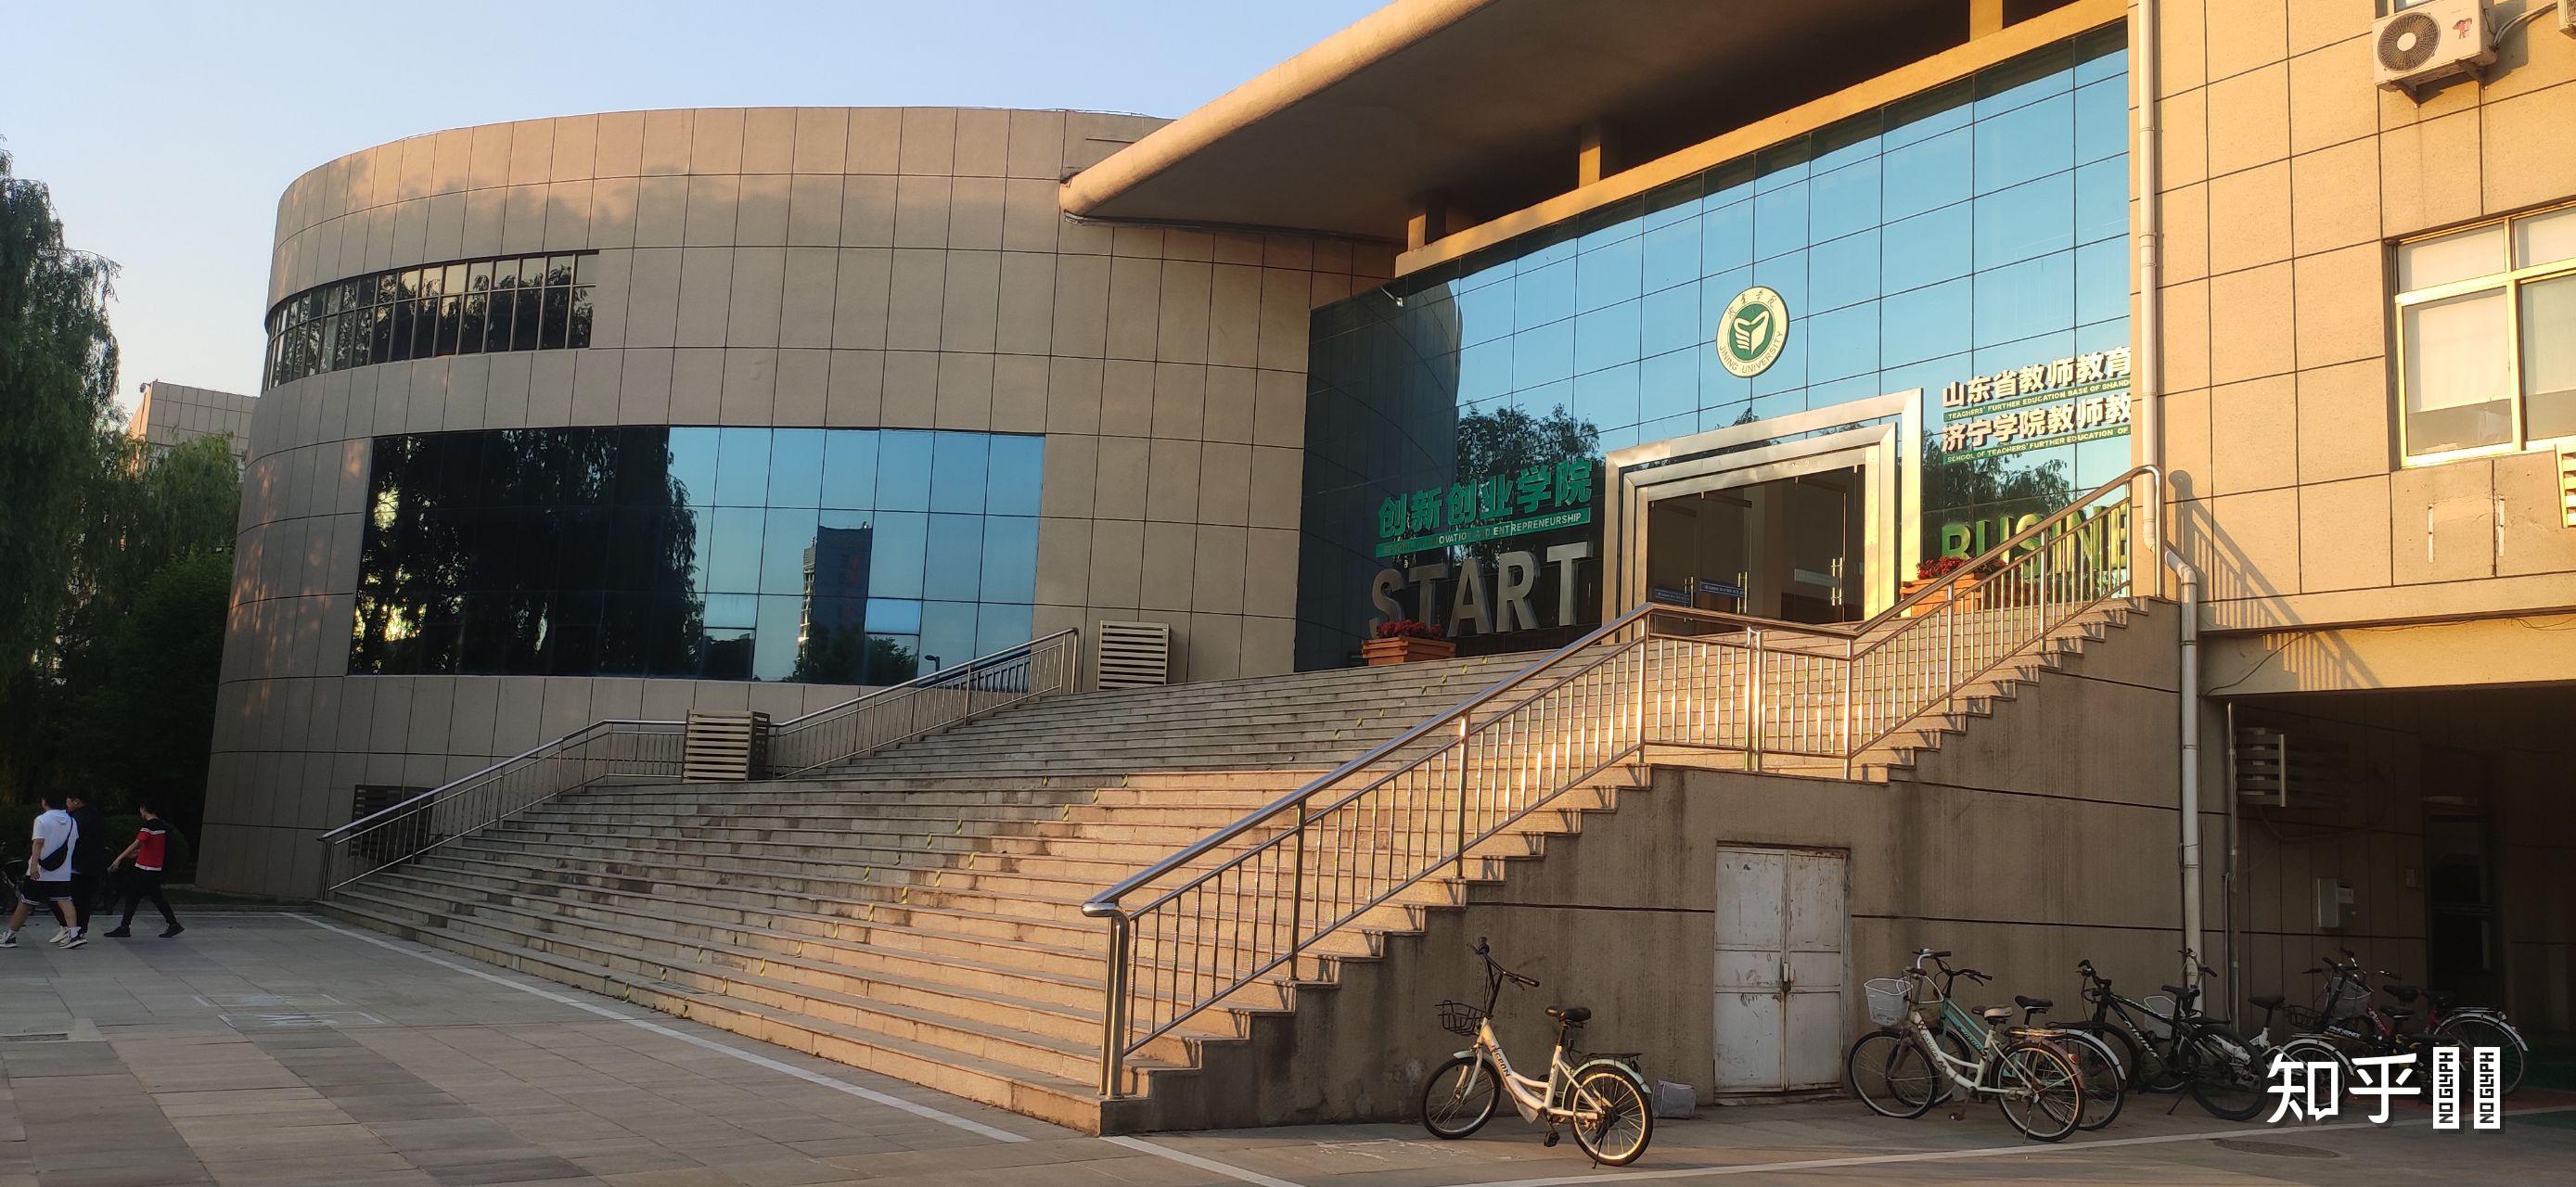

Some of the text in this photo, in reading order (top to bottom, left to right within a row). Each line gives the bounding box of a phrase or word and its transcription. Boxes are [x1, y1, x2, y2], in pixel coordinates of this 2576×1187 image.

[1741, 331, 1783, 374] UNIVERSITY
[1942, 346, 2132, 408] 山东省教师教育
[1987, 400, 2021, 412] FURTHER
[2022, 391, 2066, 405] EDUCATION
[2067, 386, 2089, 396] BASE
[2090, 384, 2102, 392] OF
[2102, 379, 2131, 389] SHAND
[1941, 391, 2132, 453] 济宁学院教师教
[1947, 452, 1976, 463] SCHOOL
[1977, 450, 1986, 458] OF
[2030, 436, 2066, 450] FURTHER
[2067, 428, 2114, 441] EDUCATION
[1378, 459, 1593, 539] 创新创业学院
[1493, 512, 1583, 536] ENTREPRENEURSHIP
[1368, 542, 1596, 640] START
